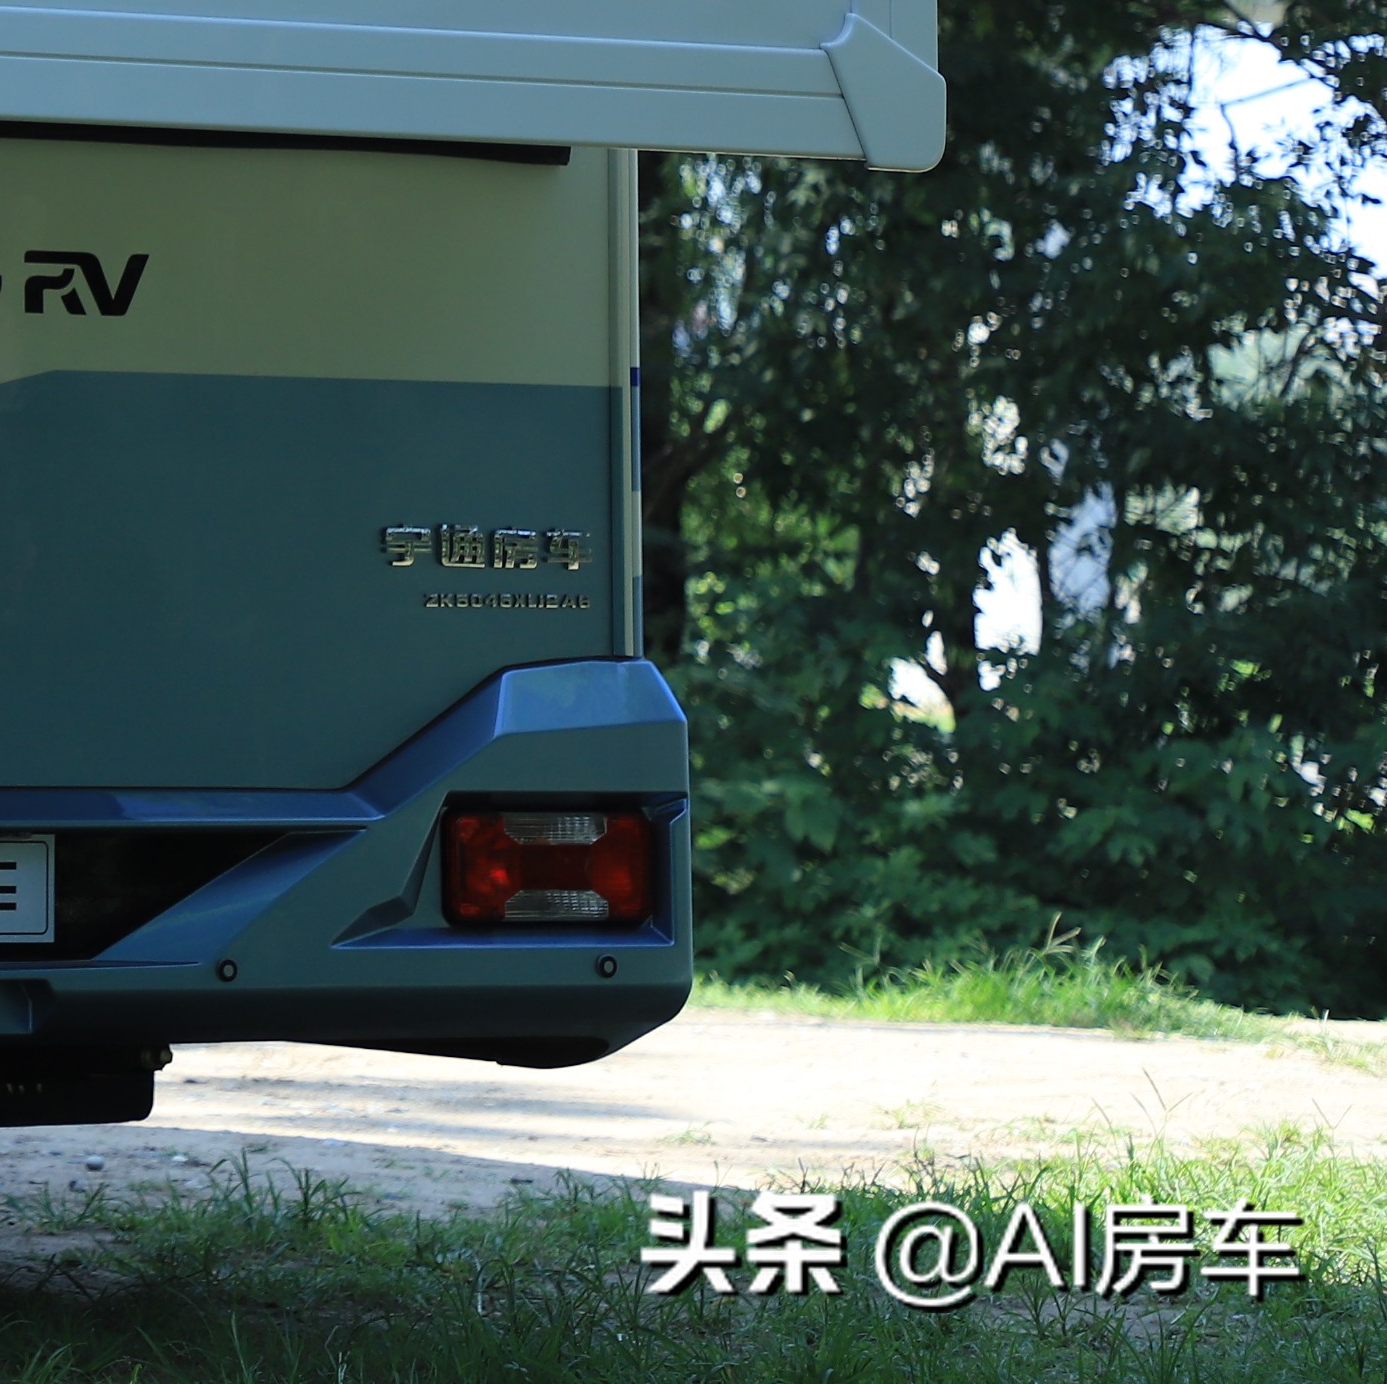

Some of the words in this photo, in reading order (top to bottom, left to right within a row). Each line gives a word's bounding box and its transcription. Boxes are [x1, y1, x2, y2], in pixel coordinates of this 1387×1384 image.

[23, 250, 149, 316] RV
[383, 524, 592, 571] 宇通房车
